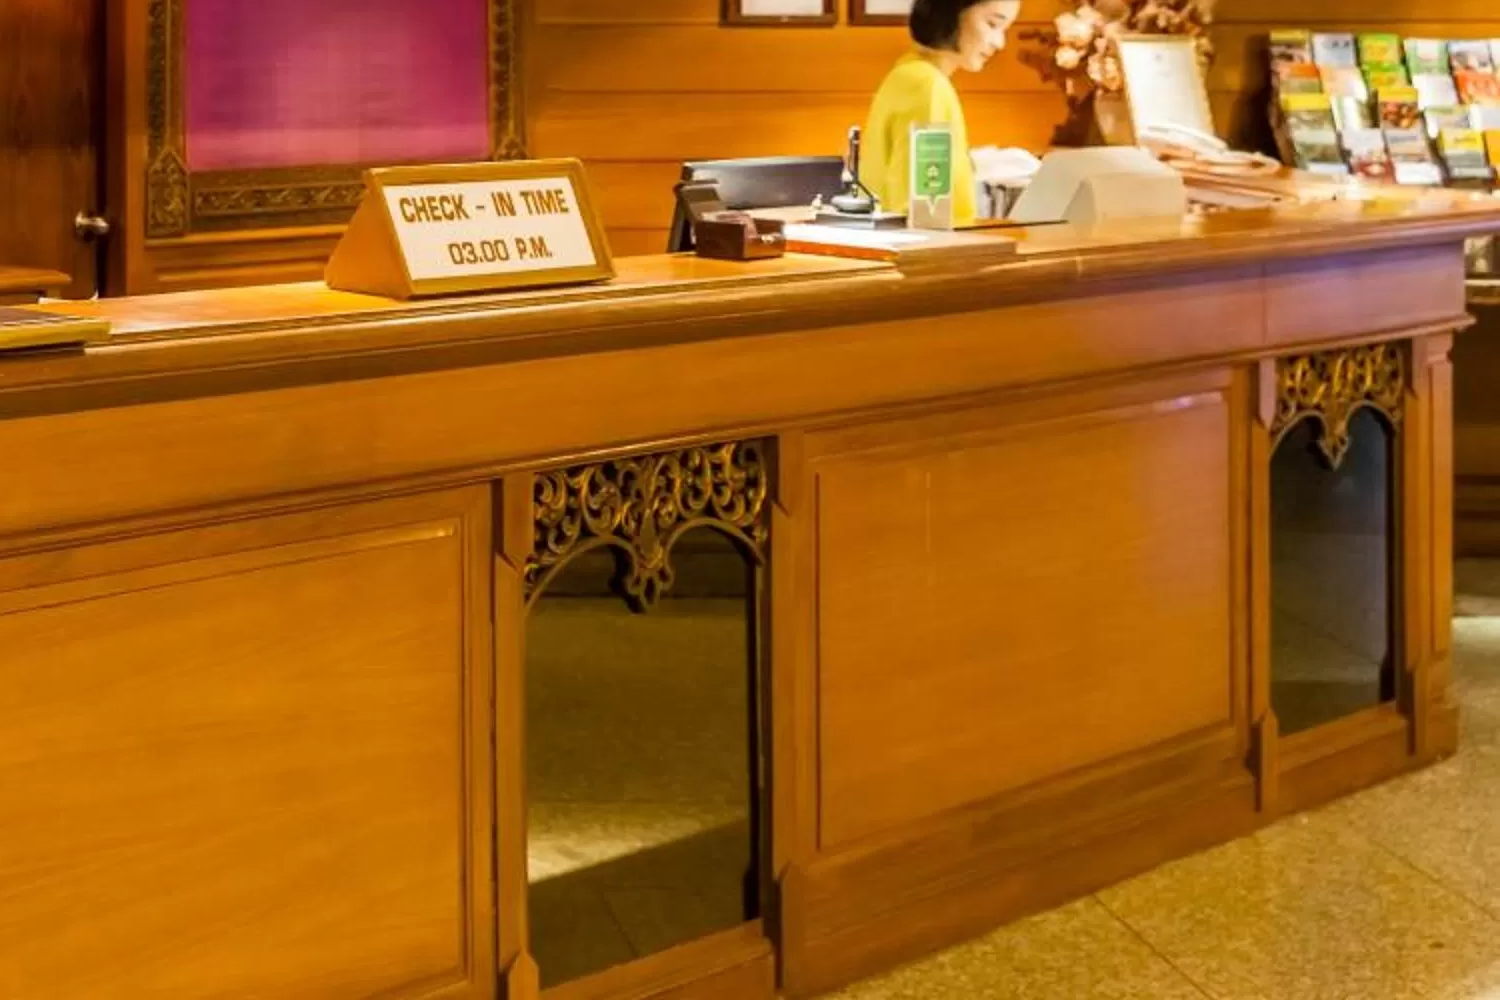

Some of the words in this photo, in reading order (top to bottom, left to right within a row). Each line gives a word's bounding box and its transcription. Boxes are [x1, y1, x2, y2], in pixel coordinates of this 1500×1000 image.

[400, 194, 469, 223] CHECK
[491, 191, 518, 217] IN
[520, 189, 570, 215] TIME
[447, 240, 509, 265] 03.00
[515, 236, 553, 261] P.M.
